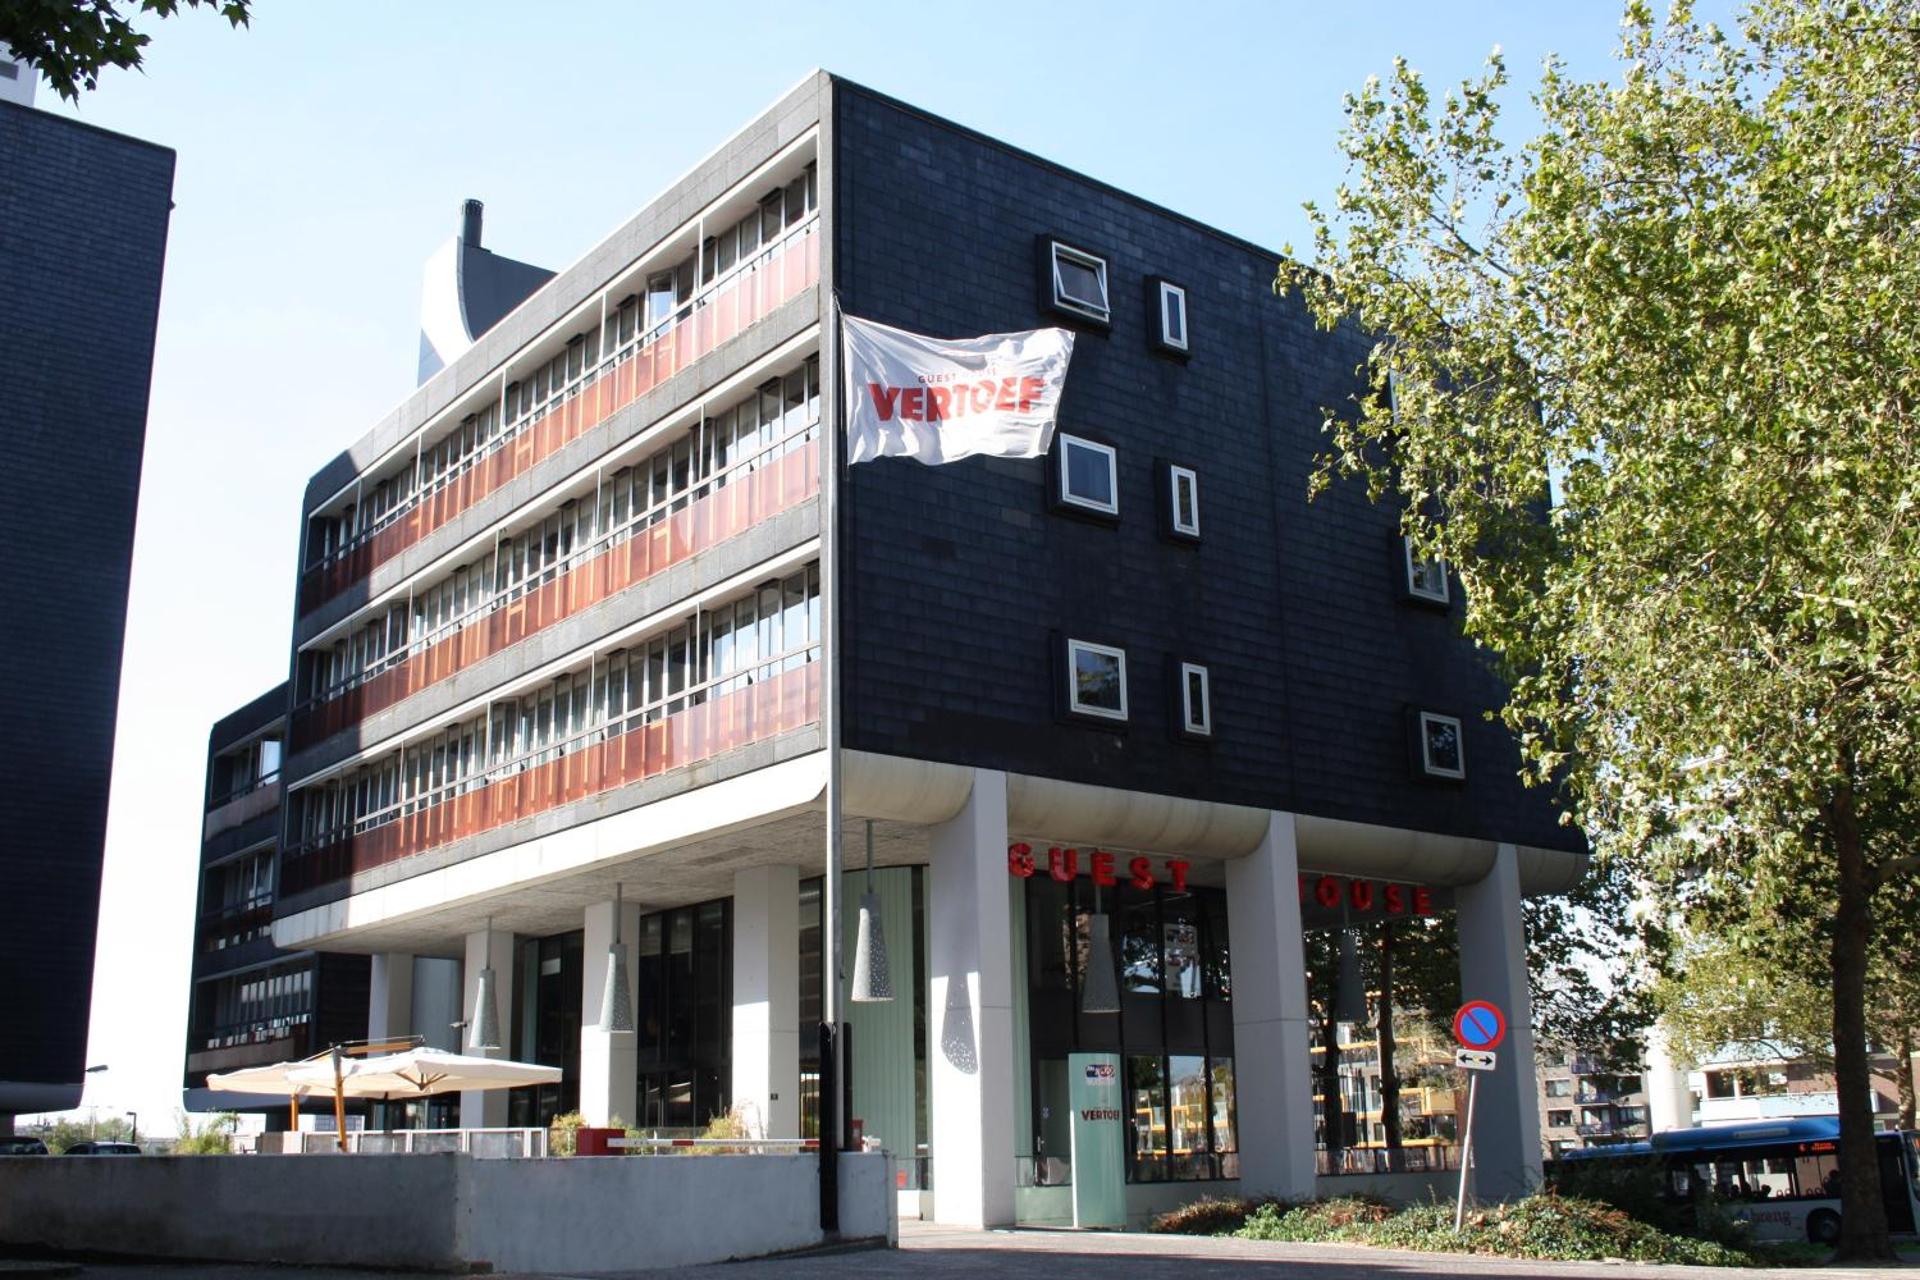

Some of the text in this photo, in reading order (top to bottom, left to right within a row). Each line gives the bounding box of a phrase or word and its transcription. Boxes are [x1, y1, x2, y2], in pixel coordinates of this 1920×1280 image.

[867, 375, 1046, 423] VERTOEF
[917, 373, 957, 384] GUEST
[1008, 842, 1191, 892] GUEST
